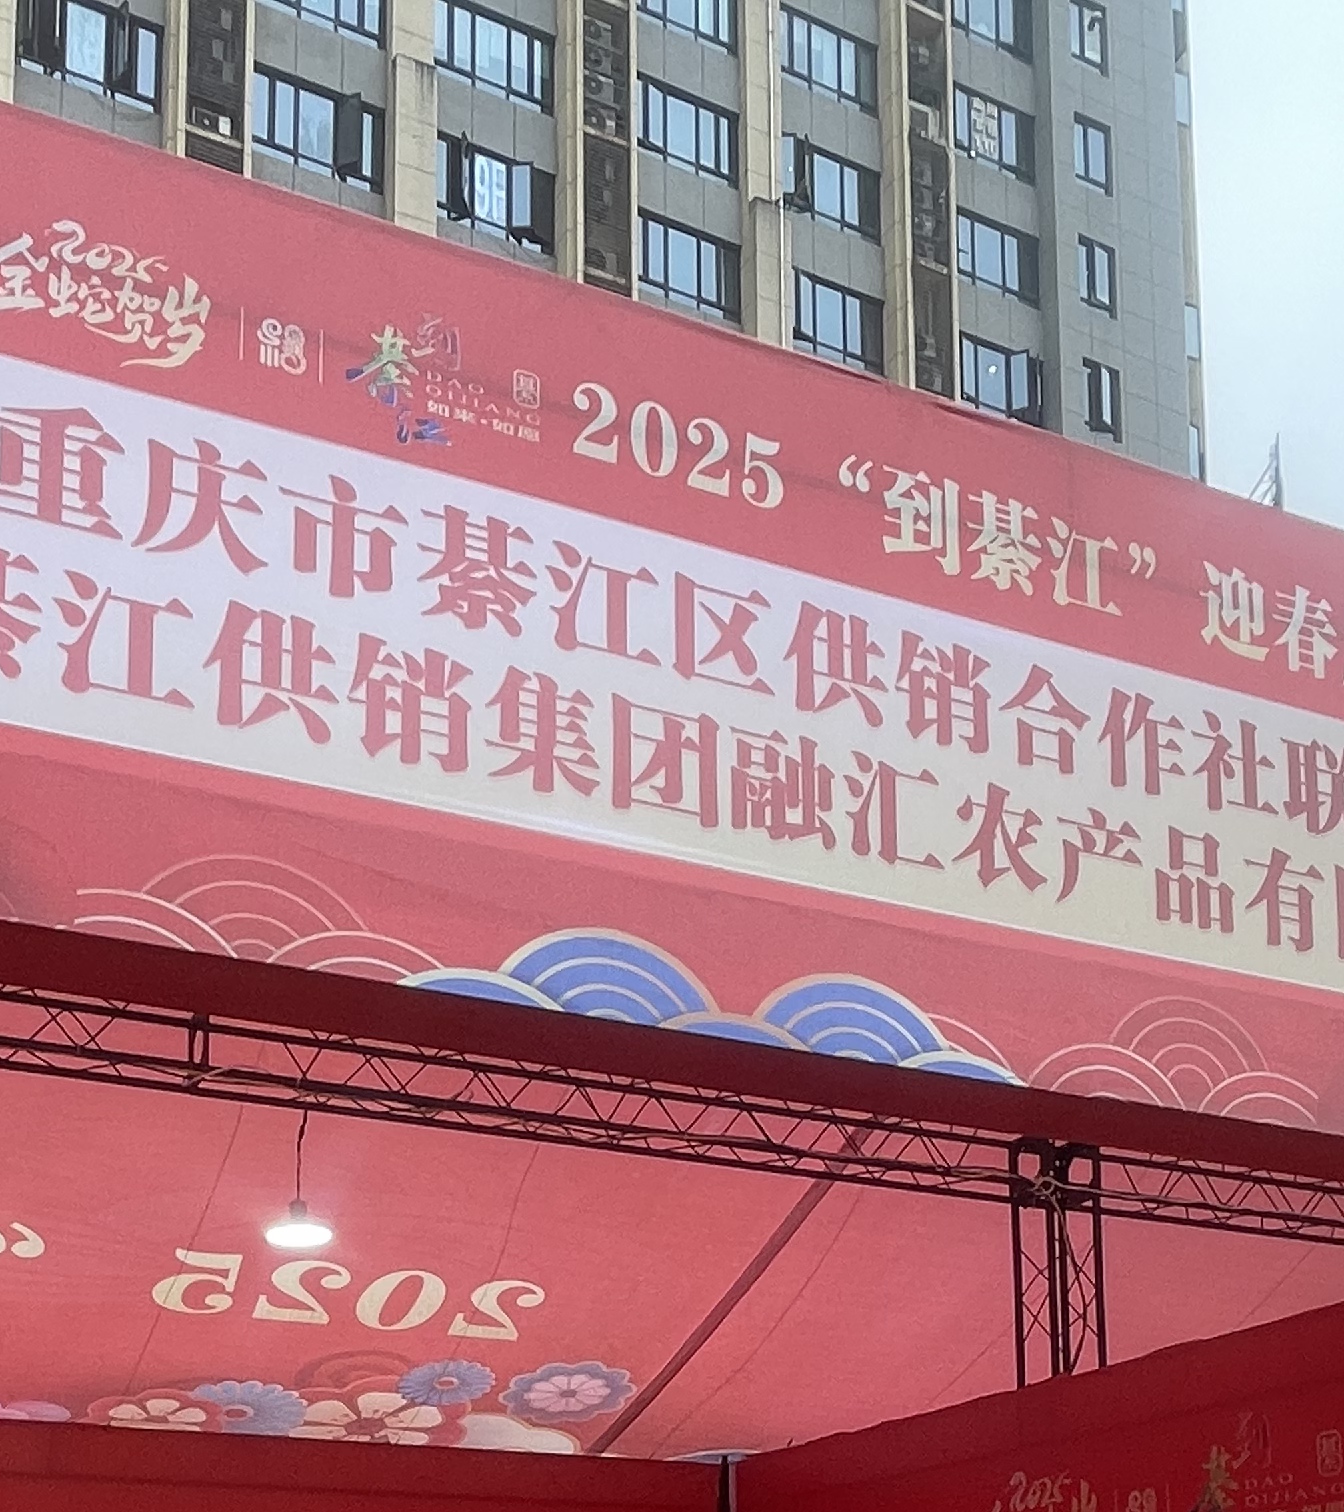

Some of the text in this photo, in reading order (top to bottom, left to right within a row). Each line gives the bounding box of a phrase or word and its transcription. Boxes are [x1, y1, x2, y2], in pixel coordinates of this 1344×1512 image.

[571, 382, 784, 510] 2025
[838, 453, 1157, 618] “到綦江”
